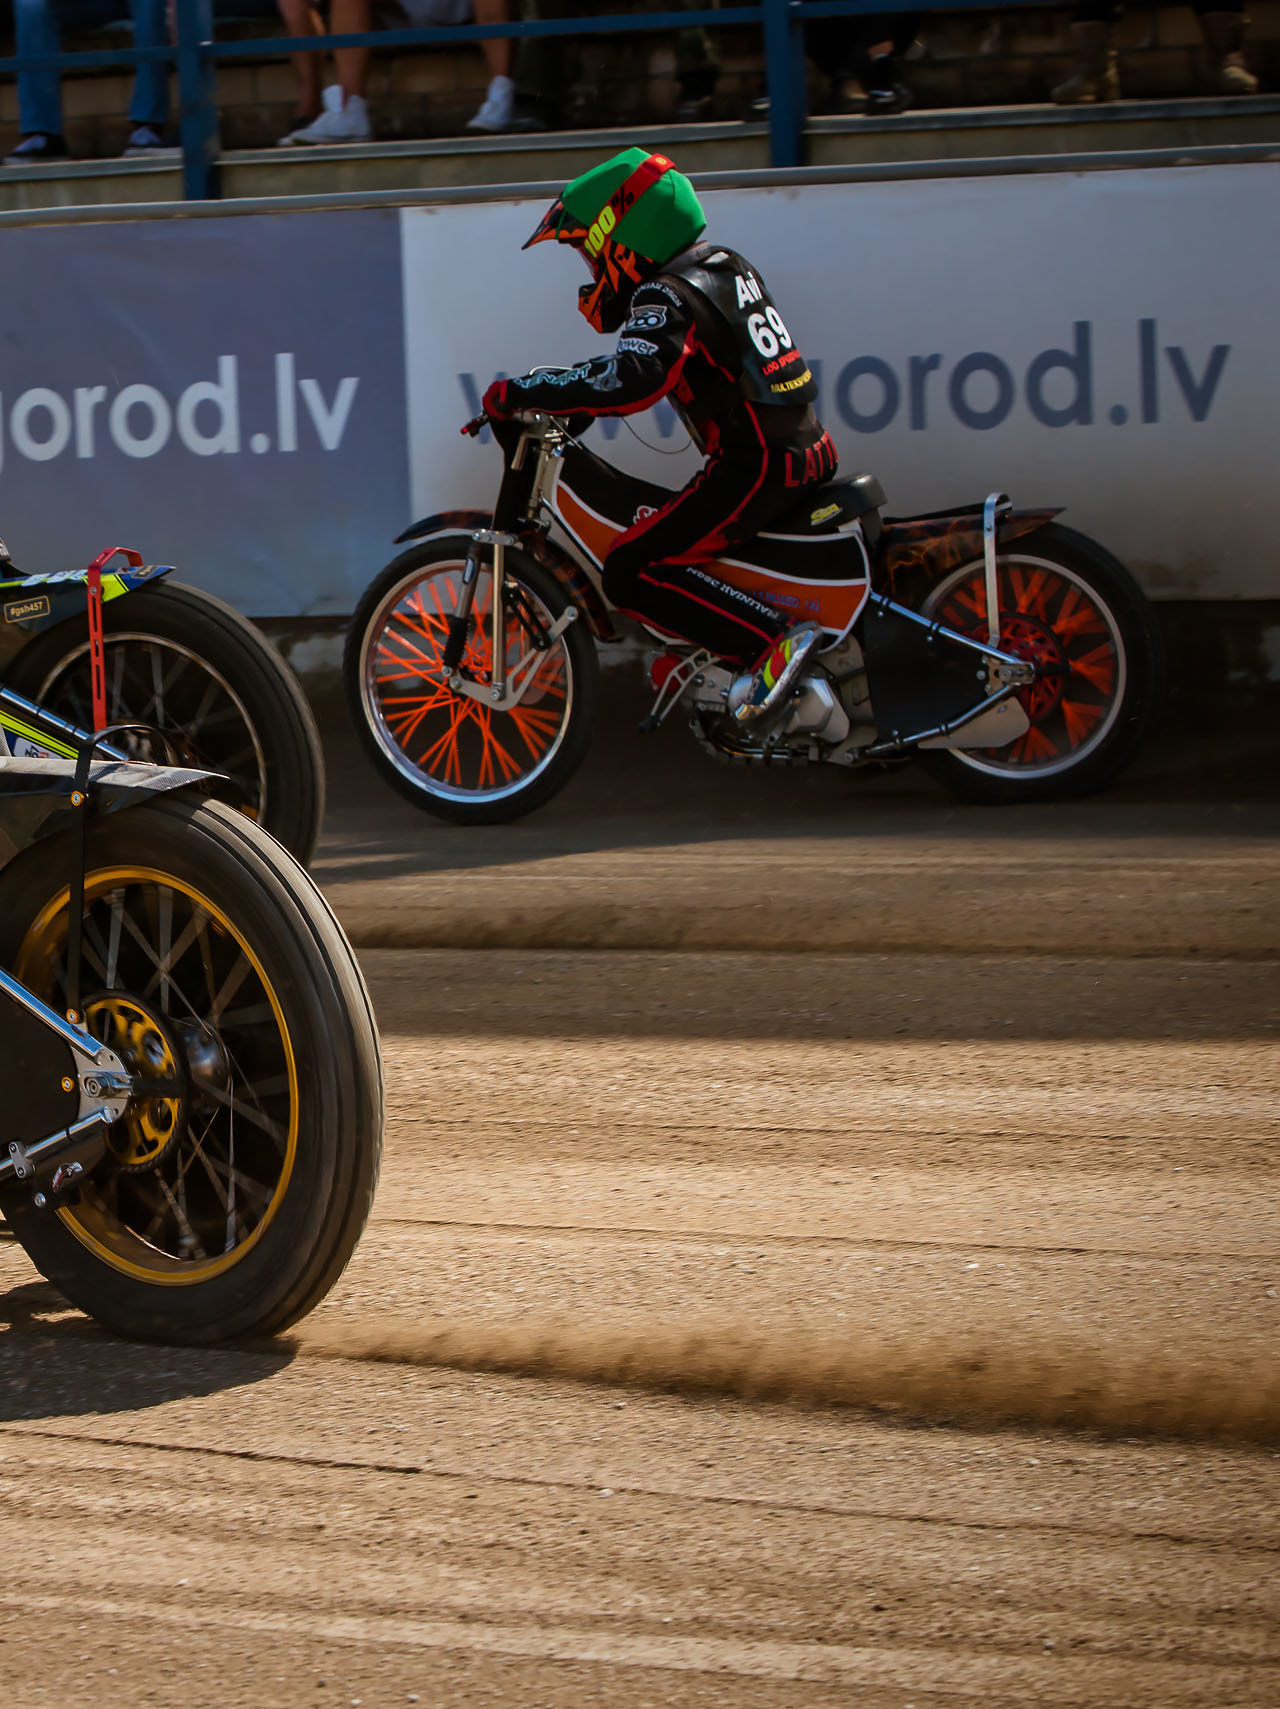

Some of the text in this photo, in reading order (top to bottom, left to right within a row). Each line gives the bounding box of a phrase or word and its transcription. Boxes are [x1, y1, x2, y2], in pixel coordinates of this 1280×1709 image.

[584, 185, 635, 259] 100%
[747, 305, 792, 358] 69
[10, 601, 43, 617] #gsh457
